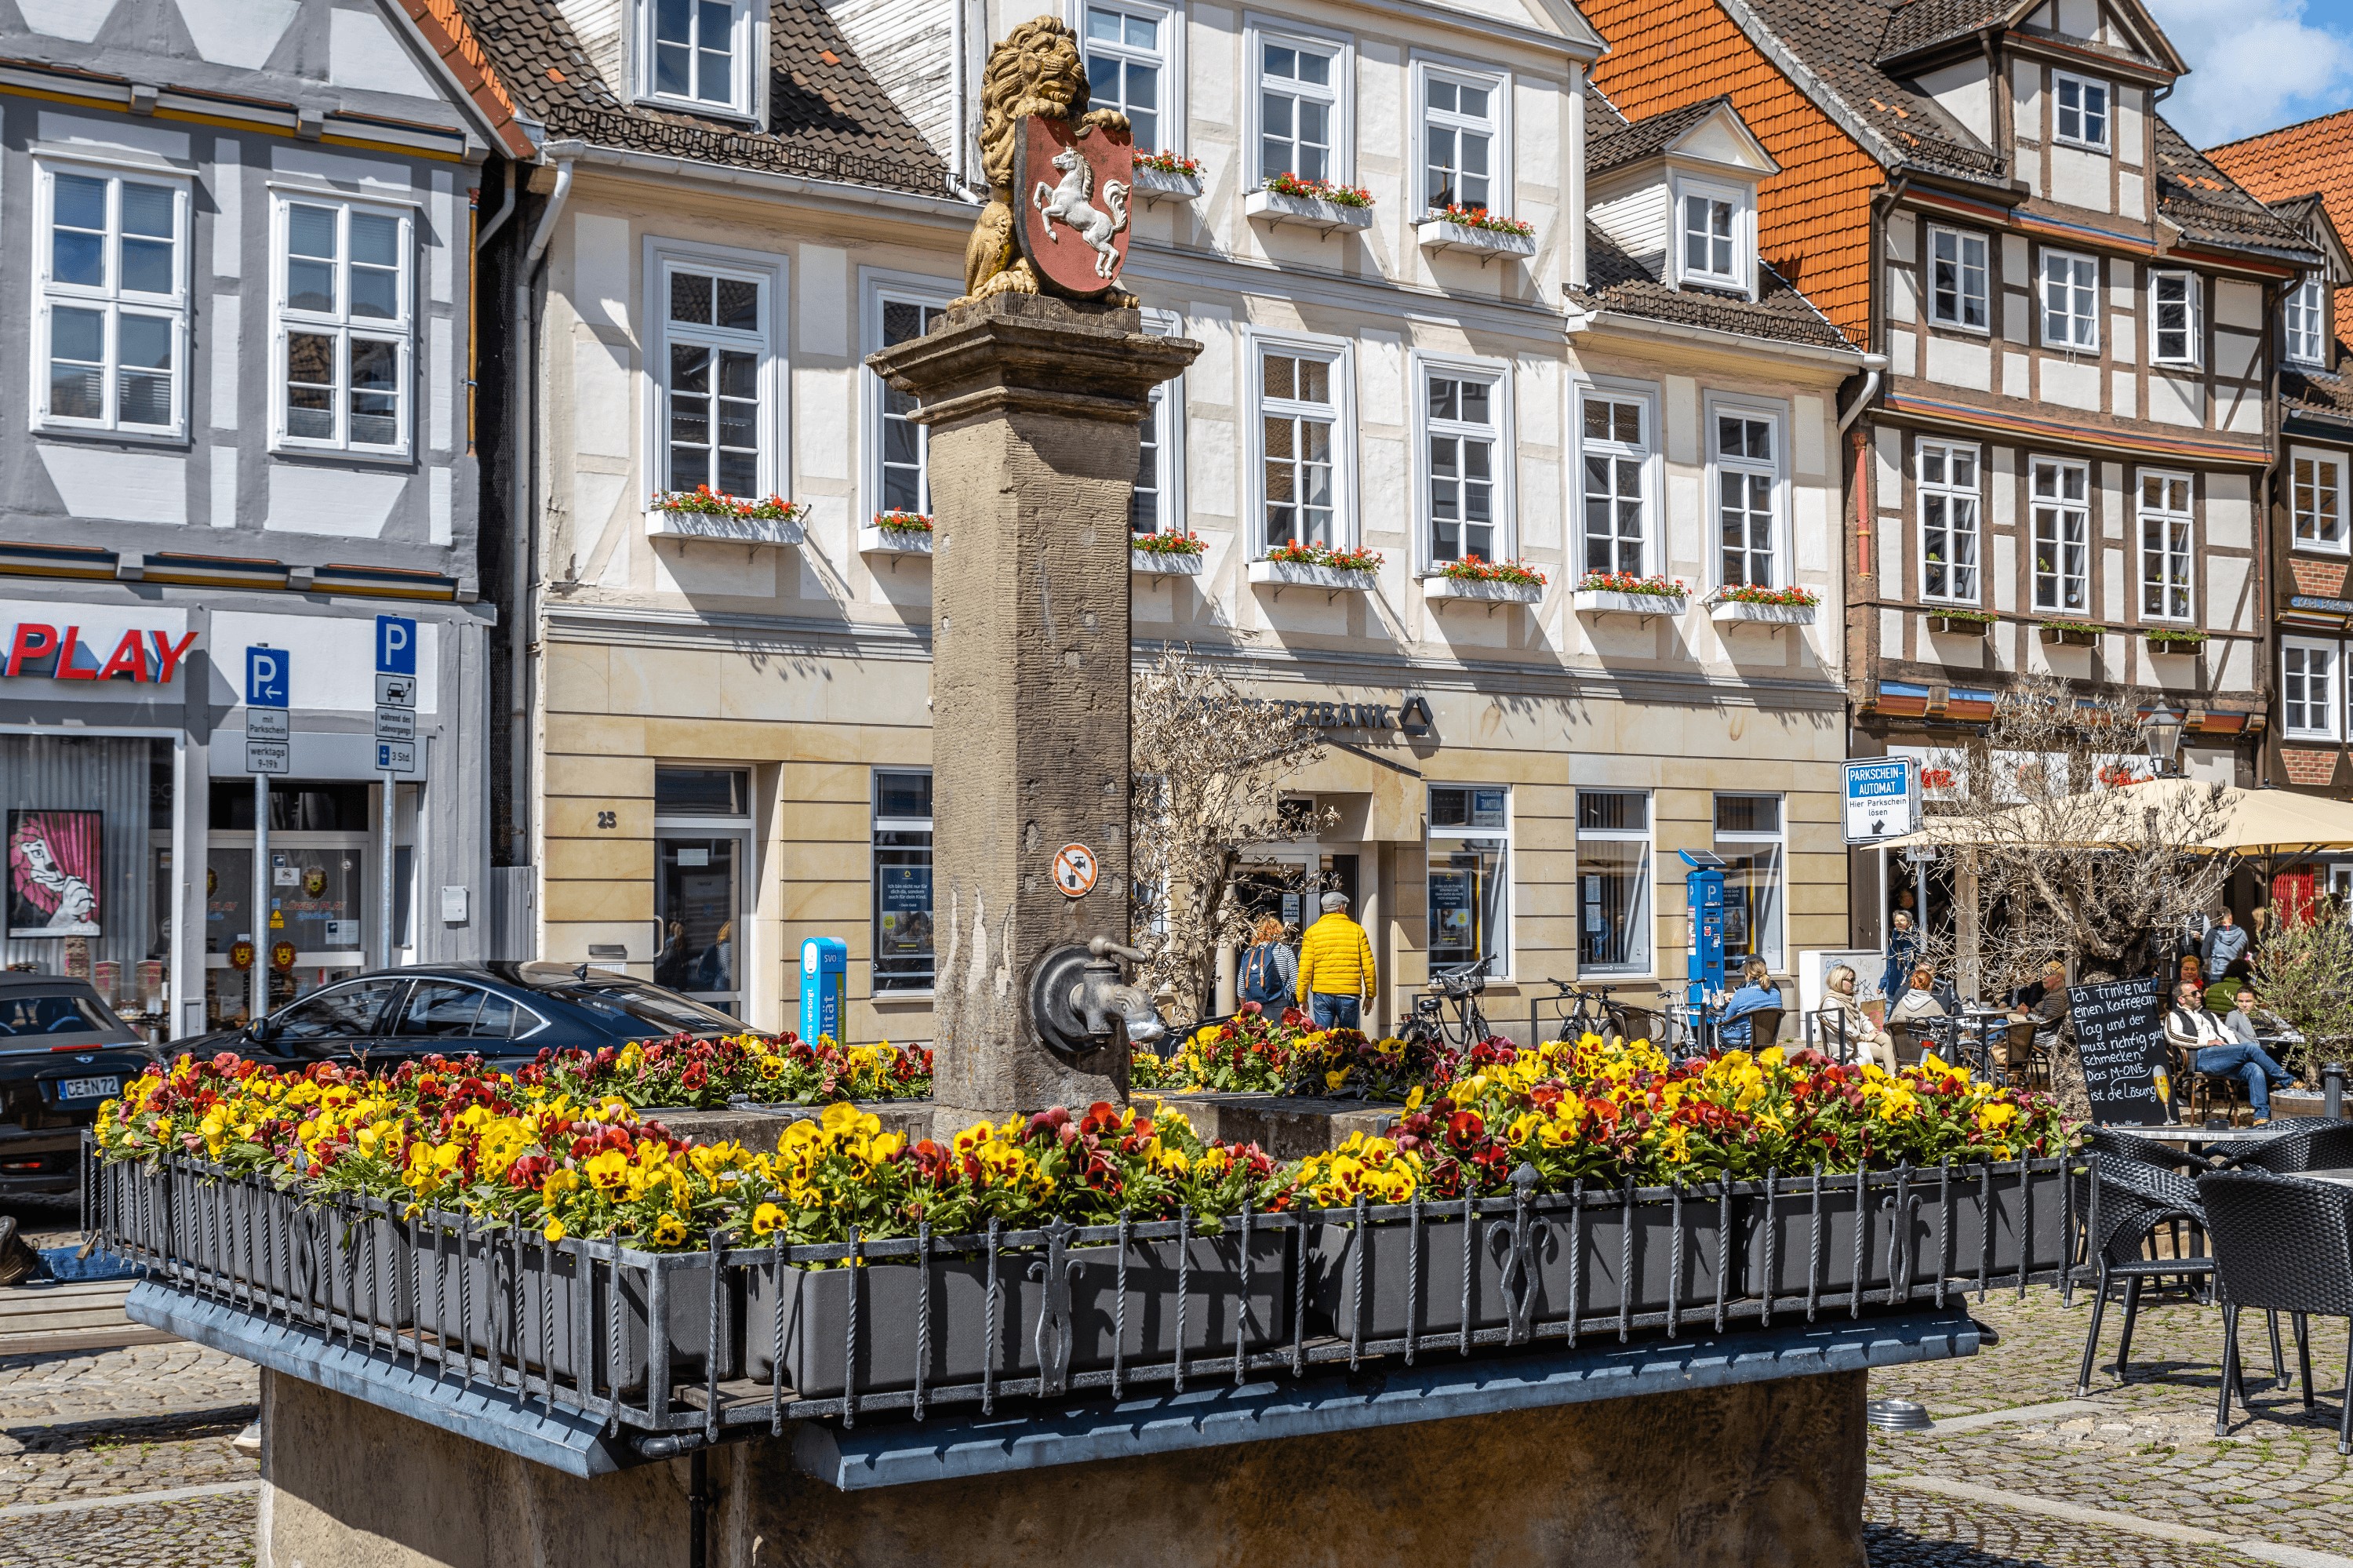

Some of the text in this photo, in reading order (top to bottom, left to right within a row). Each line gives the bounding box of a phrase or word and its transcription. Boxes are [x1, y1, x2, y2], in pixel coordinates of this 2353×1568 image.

[2299, 597, 2319, 608] KARL
[386, 624, 407, 665] P
[4, 623, 199, 683] PLAY
[253, 654, 277, 697] P
[380, 712, 411, 723] während des
[249, 724, 286, 734] Parkschein
[379, 723, 412, 736] Ladevorgangs
[250, 748, 285, 759] werktags
[392, 752, 411, 762] 3 Std.
[1850, 766, 1904, 781] PARKSCHEIN-
[1859, 781, 1896, 795] AUTOMAT
[1867, 798, 1907, 807] Parkschein
[598, 811, 617, 829] 25
[1707, 885, 1716, 900] P
[209, 901, 238, 911] PLAY
[319, 901, 347, 911] PLAY
[824, 954, 837, 962] SVO
[2068, 981, 2151, 1002] Ich trinke nur
[2074, 995, 2157, 1017] einen Kaffee am
[2075, 1014, 2146, 1041] Tag und der
[2080, 1028, 2164, 1053] muss richtig gut
[2083, 1050, 2144, 1066] schmecken.
[2086, 1063, 2146, 1082] Das M-ONE
[67, 1082, 84, 1096] CE
[2090, 1082, 2157, 1102] ist die Lösung
